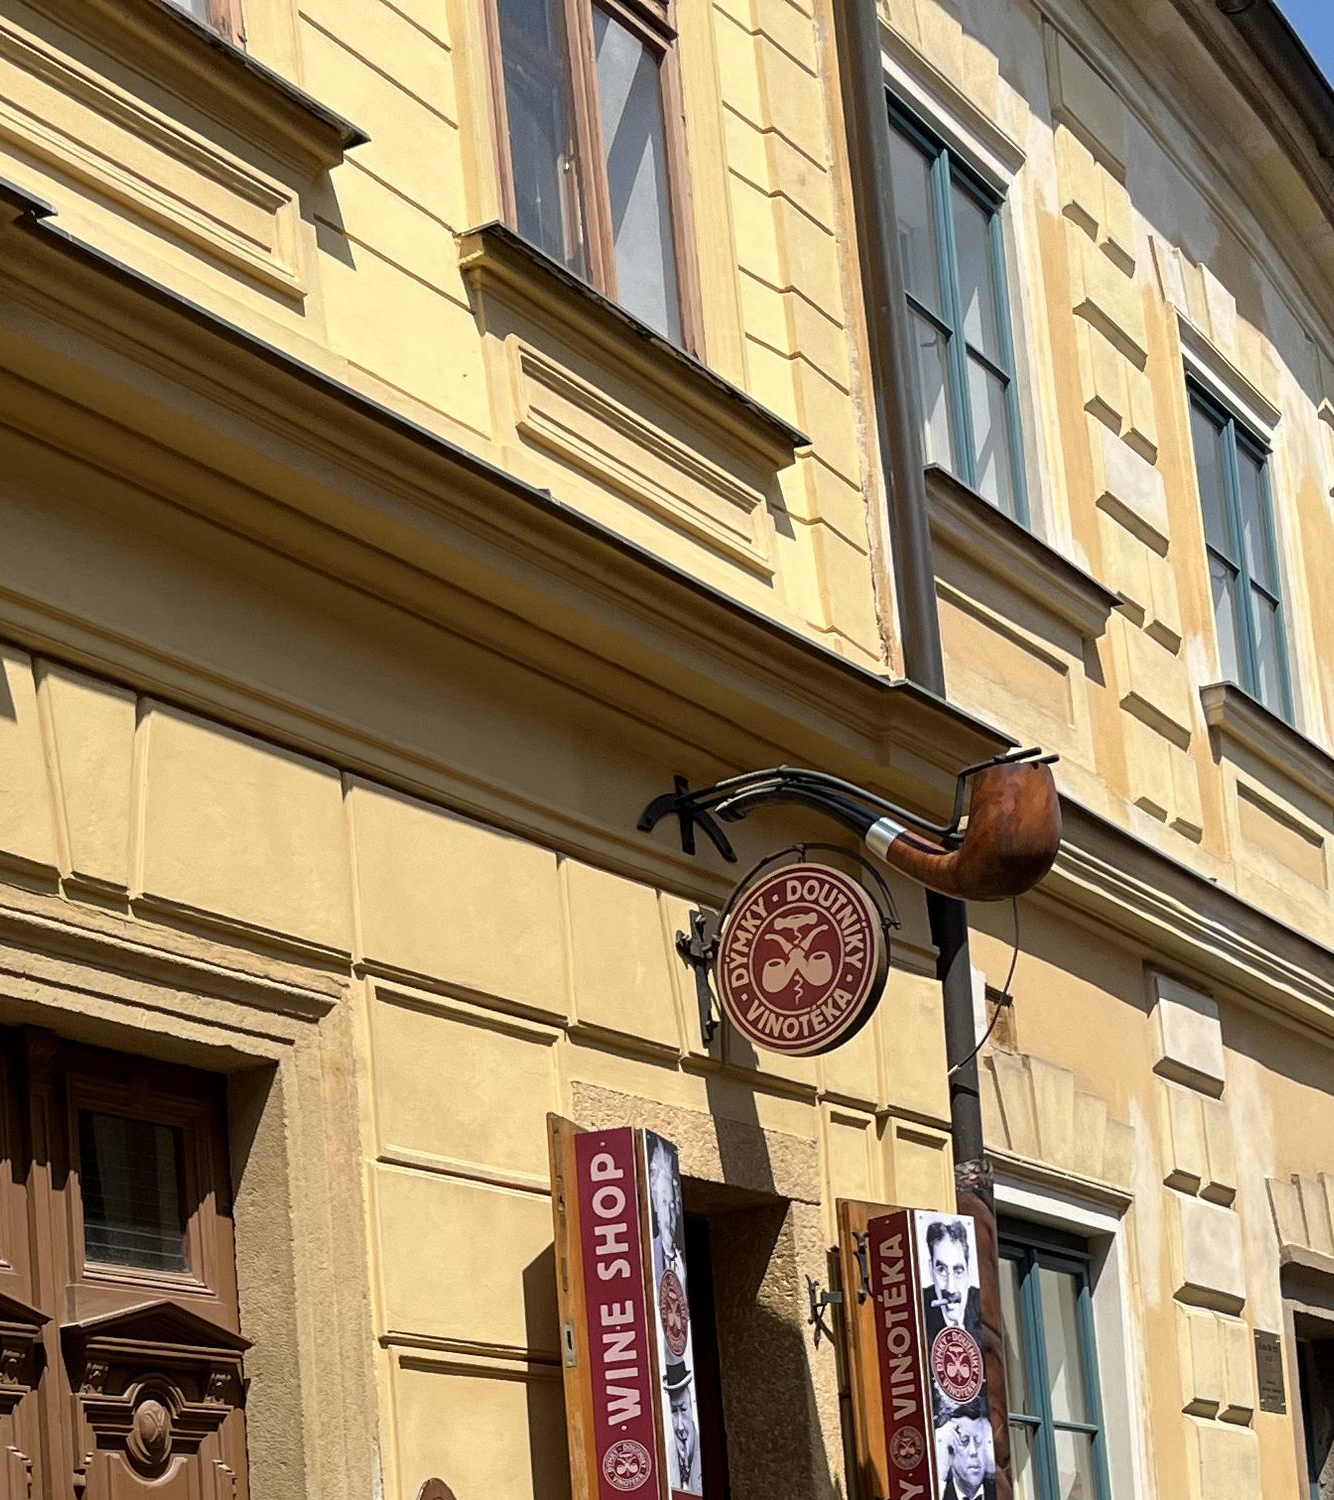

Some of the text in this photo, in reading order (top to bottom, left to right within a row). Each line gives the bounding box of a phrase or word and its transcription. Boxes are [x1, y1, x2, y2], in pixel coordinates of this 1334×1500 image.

[725, 896, 768, 988] DÝMKY
[786, 879, 867, 970] DOUTNÍKY
[745, 987, 854, 1039] VINOTÉKA
[589, 1151, 631, 1282] SHOP
[599, 1299, 642, 1427] WINE
[877, 1232, 917, 1423] VINOTÉKA
